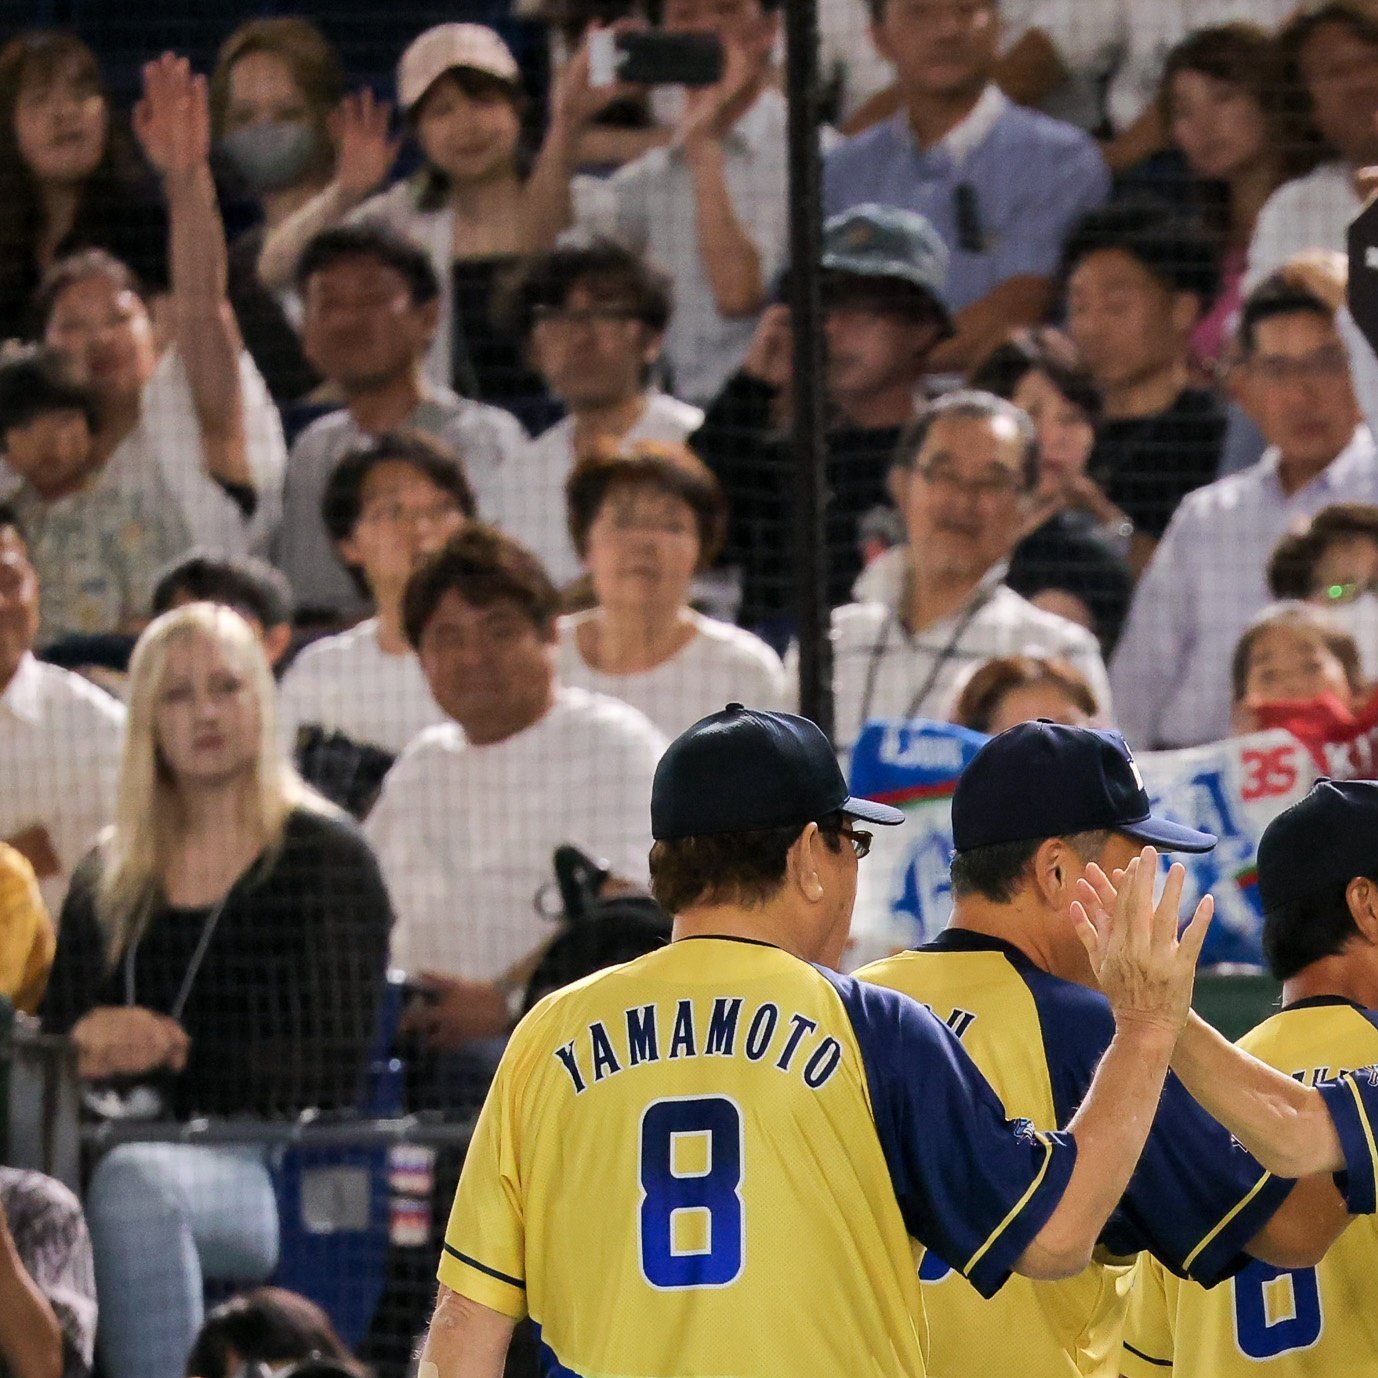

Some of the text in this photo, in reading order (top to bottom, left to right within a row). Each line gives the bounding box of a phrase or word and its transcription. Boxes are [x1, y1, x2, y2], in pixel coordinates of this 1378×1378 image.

[1240, 744, 1299, 801] 35
[554, 997, 843, 1094] YAMAMOTO
[637, 1093, 745, 1292] 8
